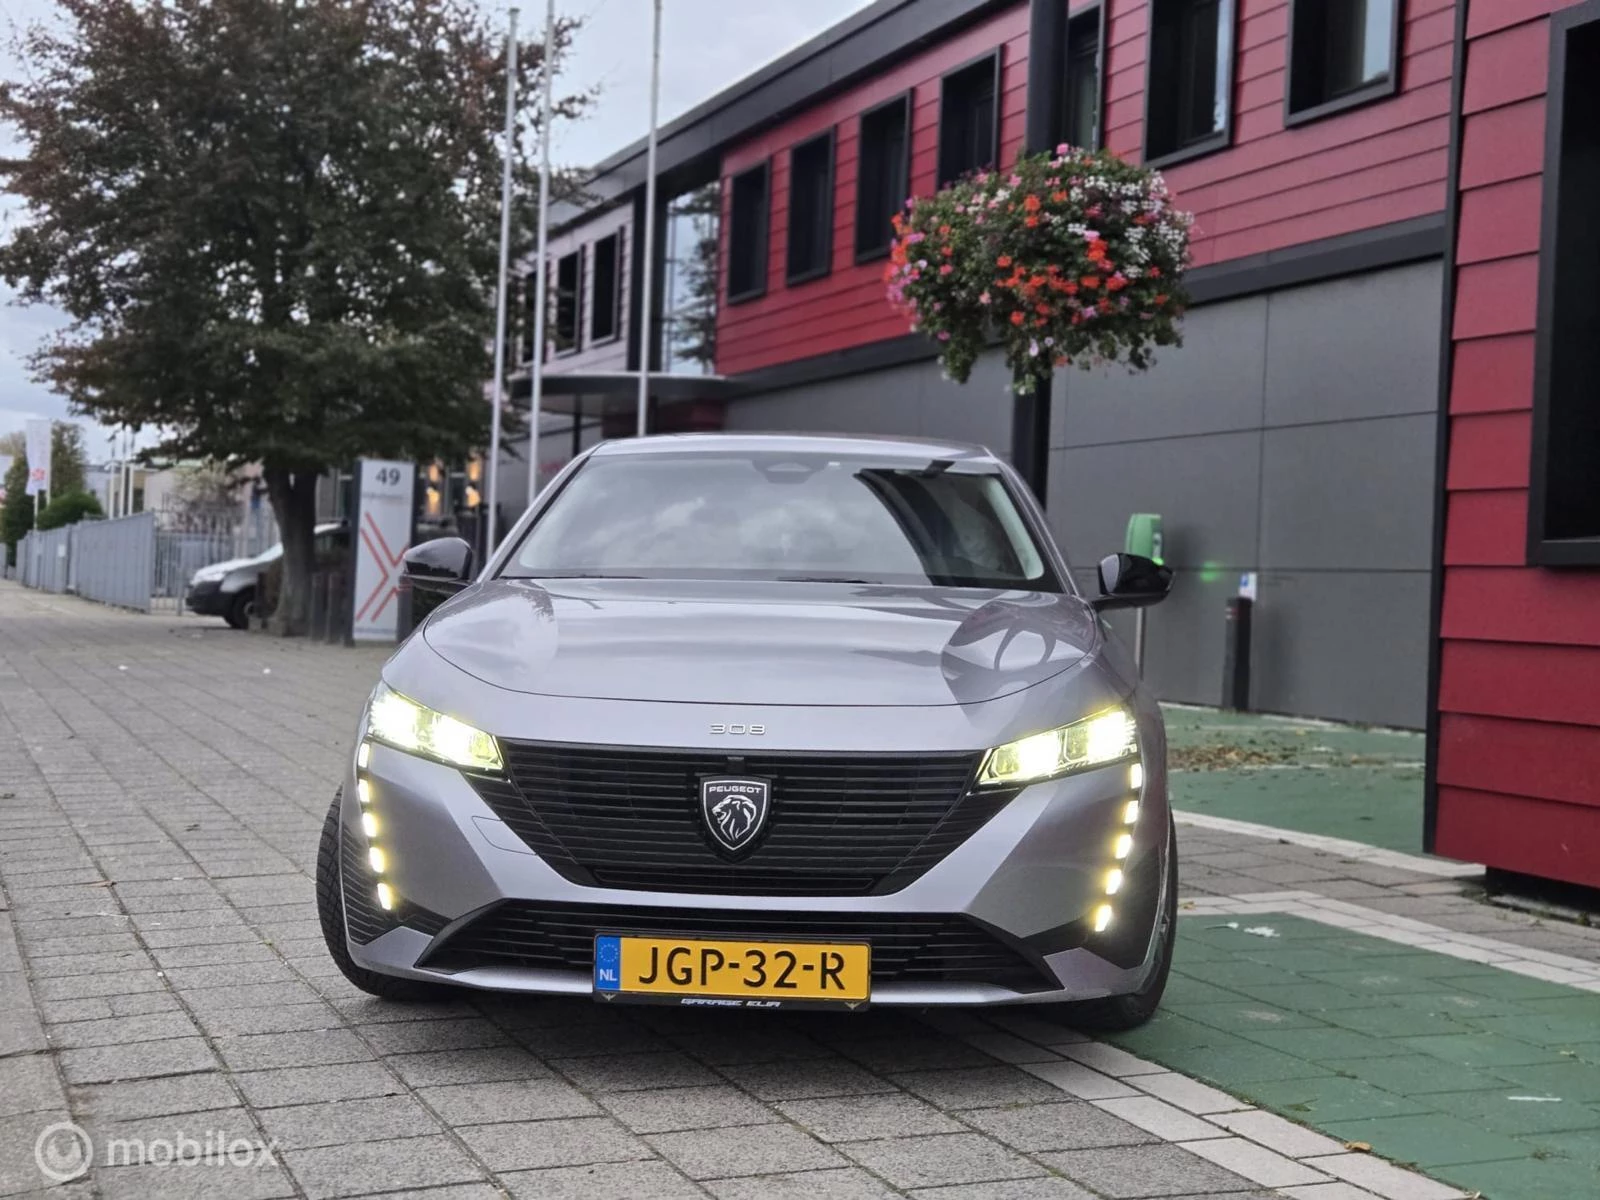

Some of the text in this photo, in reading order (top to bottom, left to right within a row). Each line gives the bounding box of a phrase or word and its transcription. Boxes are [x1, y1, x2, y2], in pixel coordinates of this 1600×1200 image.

[375, 467, 401, 487] 49
[709, 723, 765, 735] 308
[708, 785, 762, 794] PEUGEOT
[599, 946, 846, 991] NL JGP-32-R
[681, 998, 743, 1007] GARAGE
